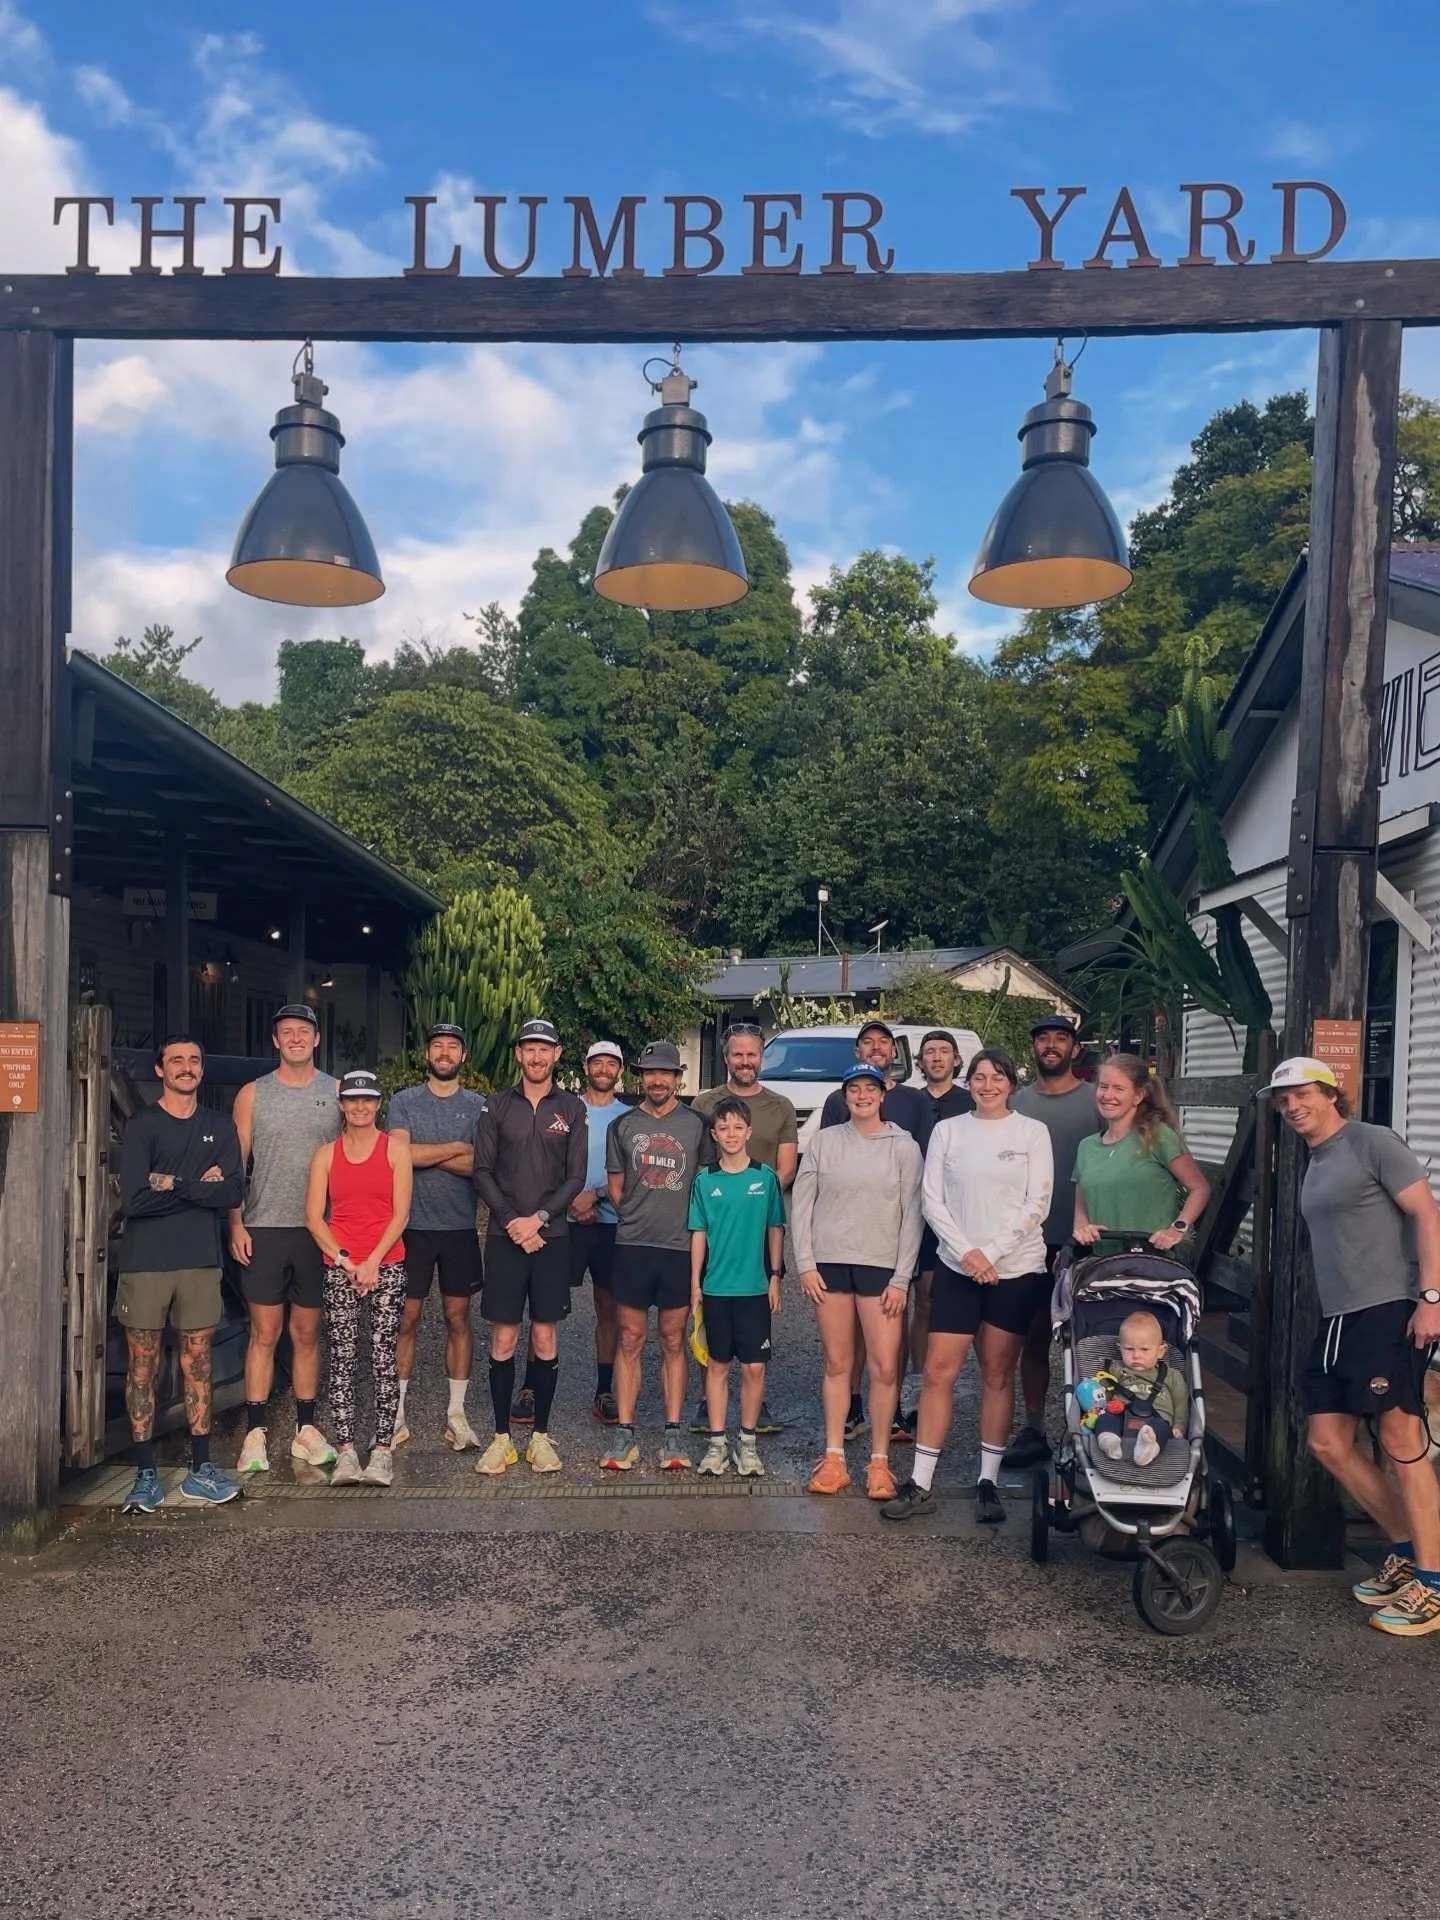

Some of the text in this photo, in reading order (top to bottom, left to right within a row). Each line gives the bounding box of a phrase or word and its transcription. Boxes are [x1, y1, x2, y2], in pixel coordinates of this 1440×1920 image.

[53, 180, 1348, 279] THE LUMBER YARD
[0, 1047, 33, 1056] NO ENTRY
[1318, 1045, 1355, 1054] NO ENTRY
[2, 1063, 31, 1071] VISITORS
[8, 1072, 26, 1080] CARS
[8, 1081, 25, 1089] ONLY
[656, 1156, 676, 1168] MILER
